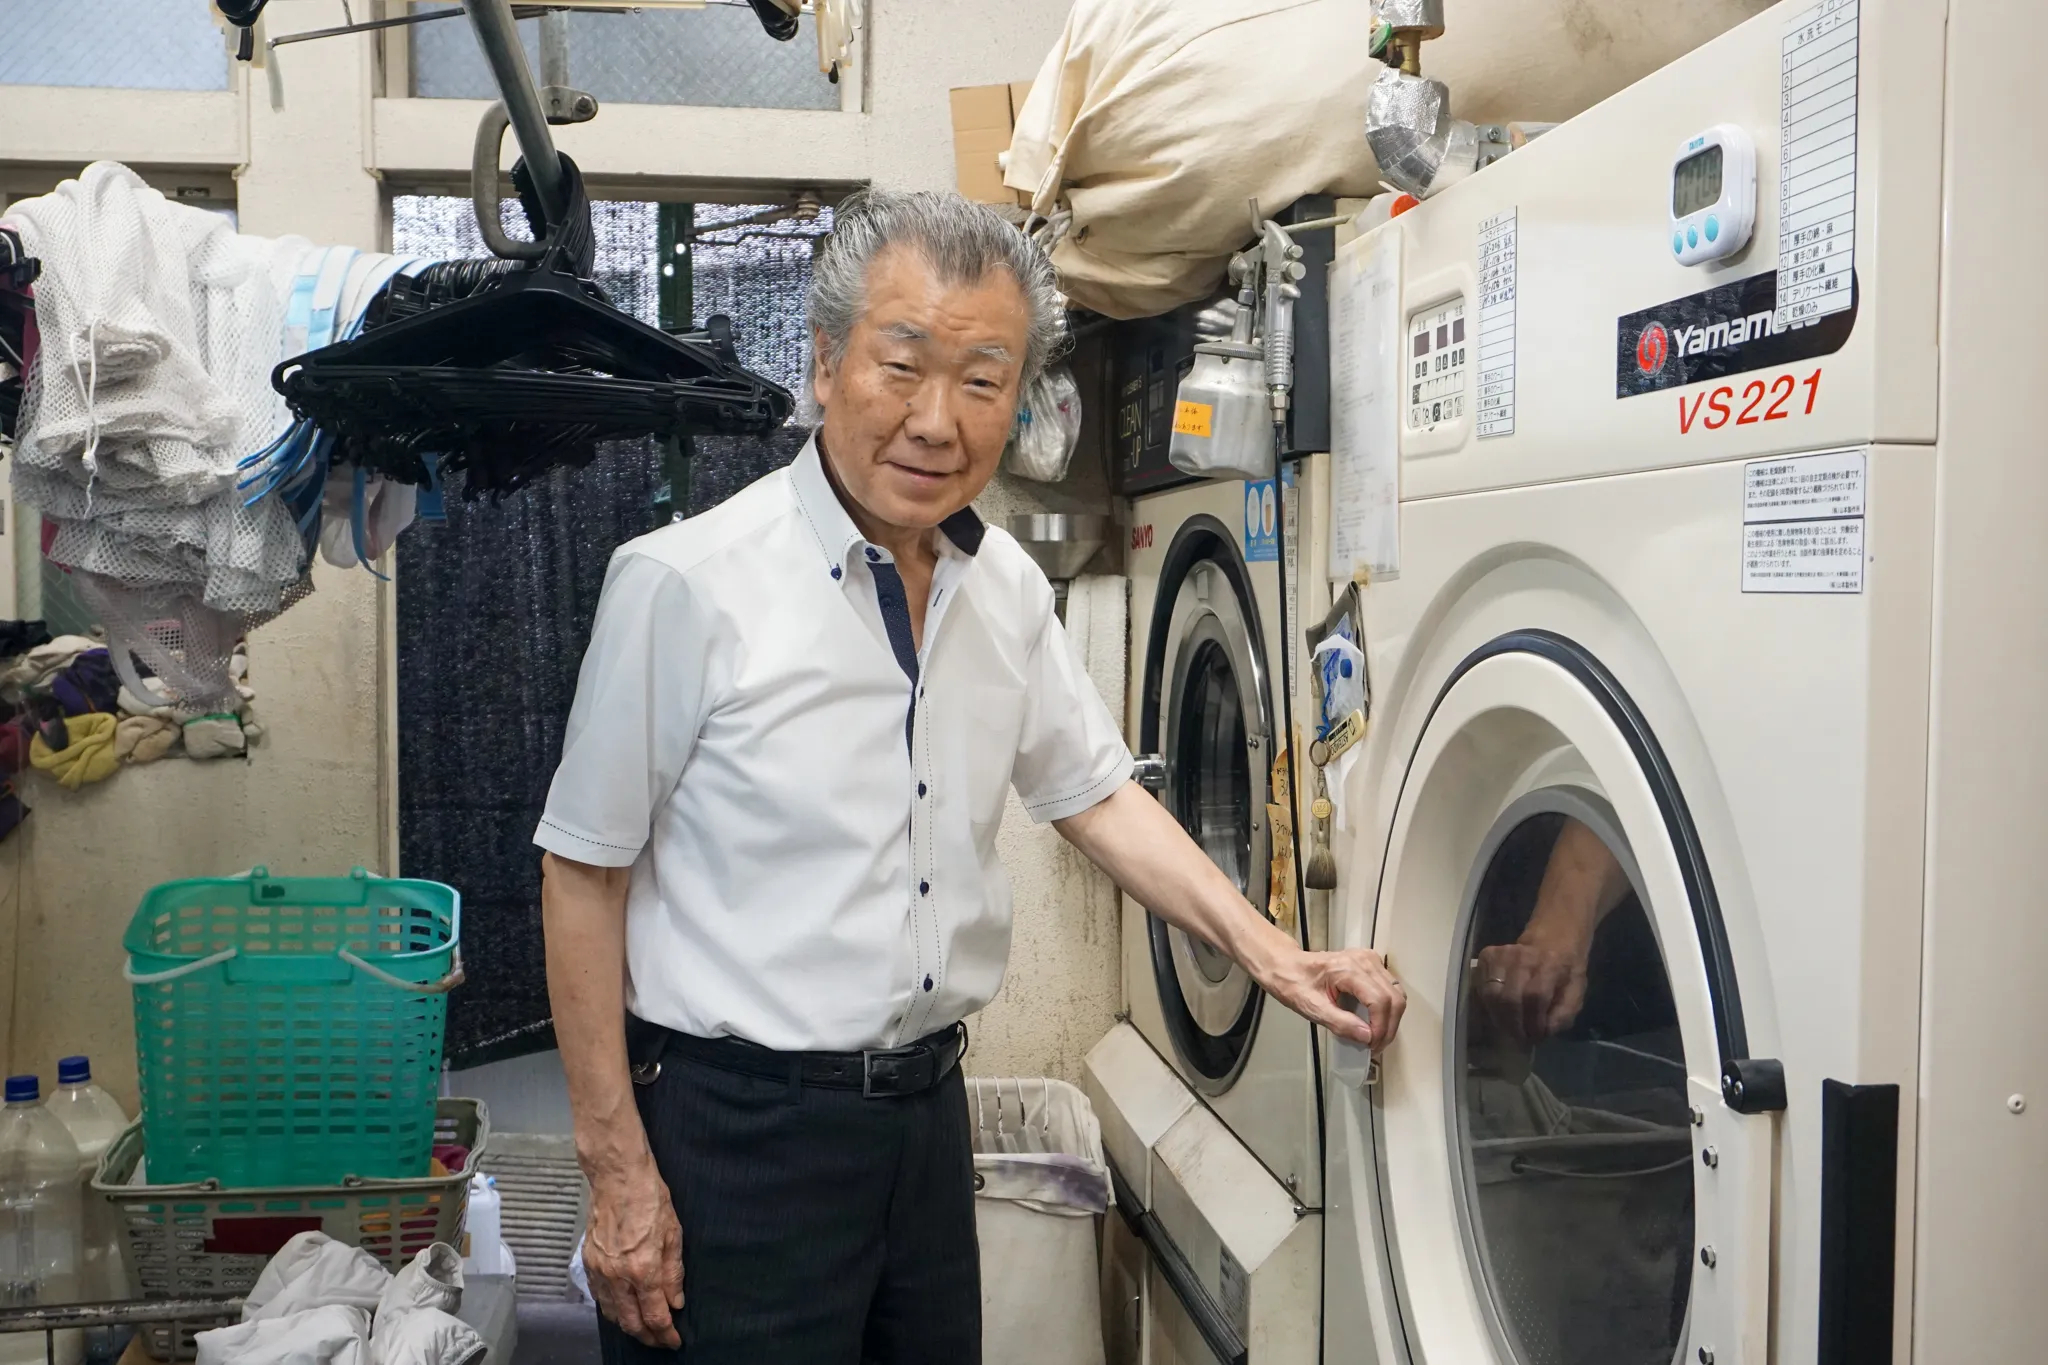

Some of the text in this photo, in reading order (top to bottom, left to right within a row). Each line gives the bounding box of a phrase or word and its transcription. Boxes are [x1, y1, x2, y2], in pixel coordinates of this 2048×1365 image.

[1797, 12, 1842, 45] 水洗モード
[1784, 58, 1789, 70] 1
[1784, 77, 1789, 89] 2
[1784, 94, 1789, 107] 3
[1783, 112, 1789, 124] 4
[1783, 130, 1789, 142] 5
[1783, 148, 1788, 160] 6
[1783, 166, 1788, 179] 7
[1782, 184, 1788, 197] 8
[1782, 202, 1788, 215] 9
[1781, 219, 1788, 233] 10
[1781, 238, 1788, 251] 11
[1780, 255, 1788, 269] 12
[1780, 273, 1787, 287] 13
[1779, 290, 1787, 304] 14
[1779, 308, 1787, 322] 15
[1673, 310, 1822, 357] Yamam
[1679, 368, 1822, 434] VS221
[1131, 524, 1153, 550] SANYO
